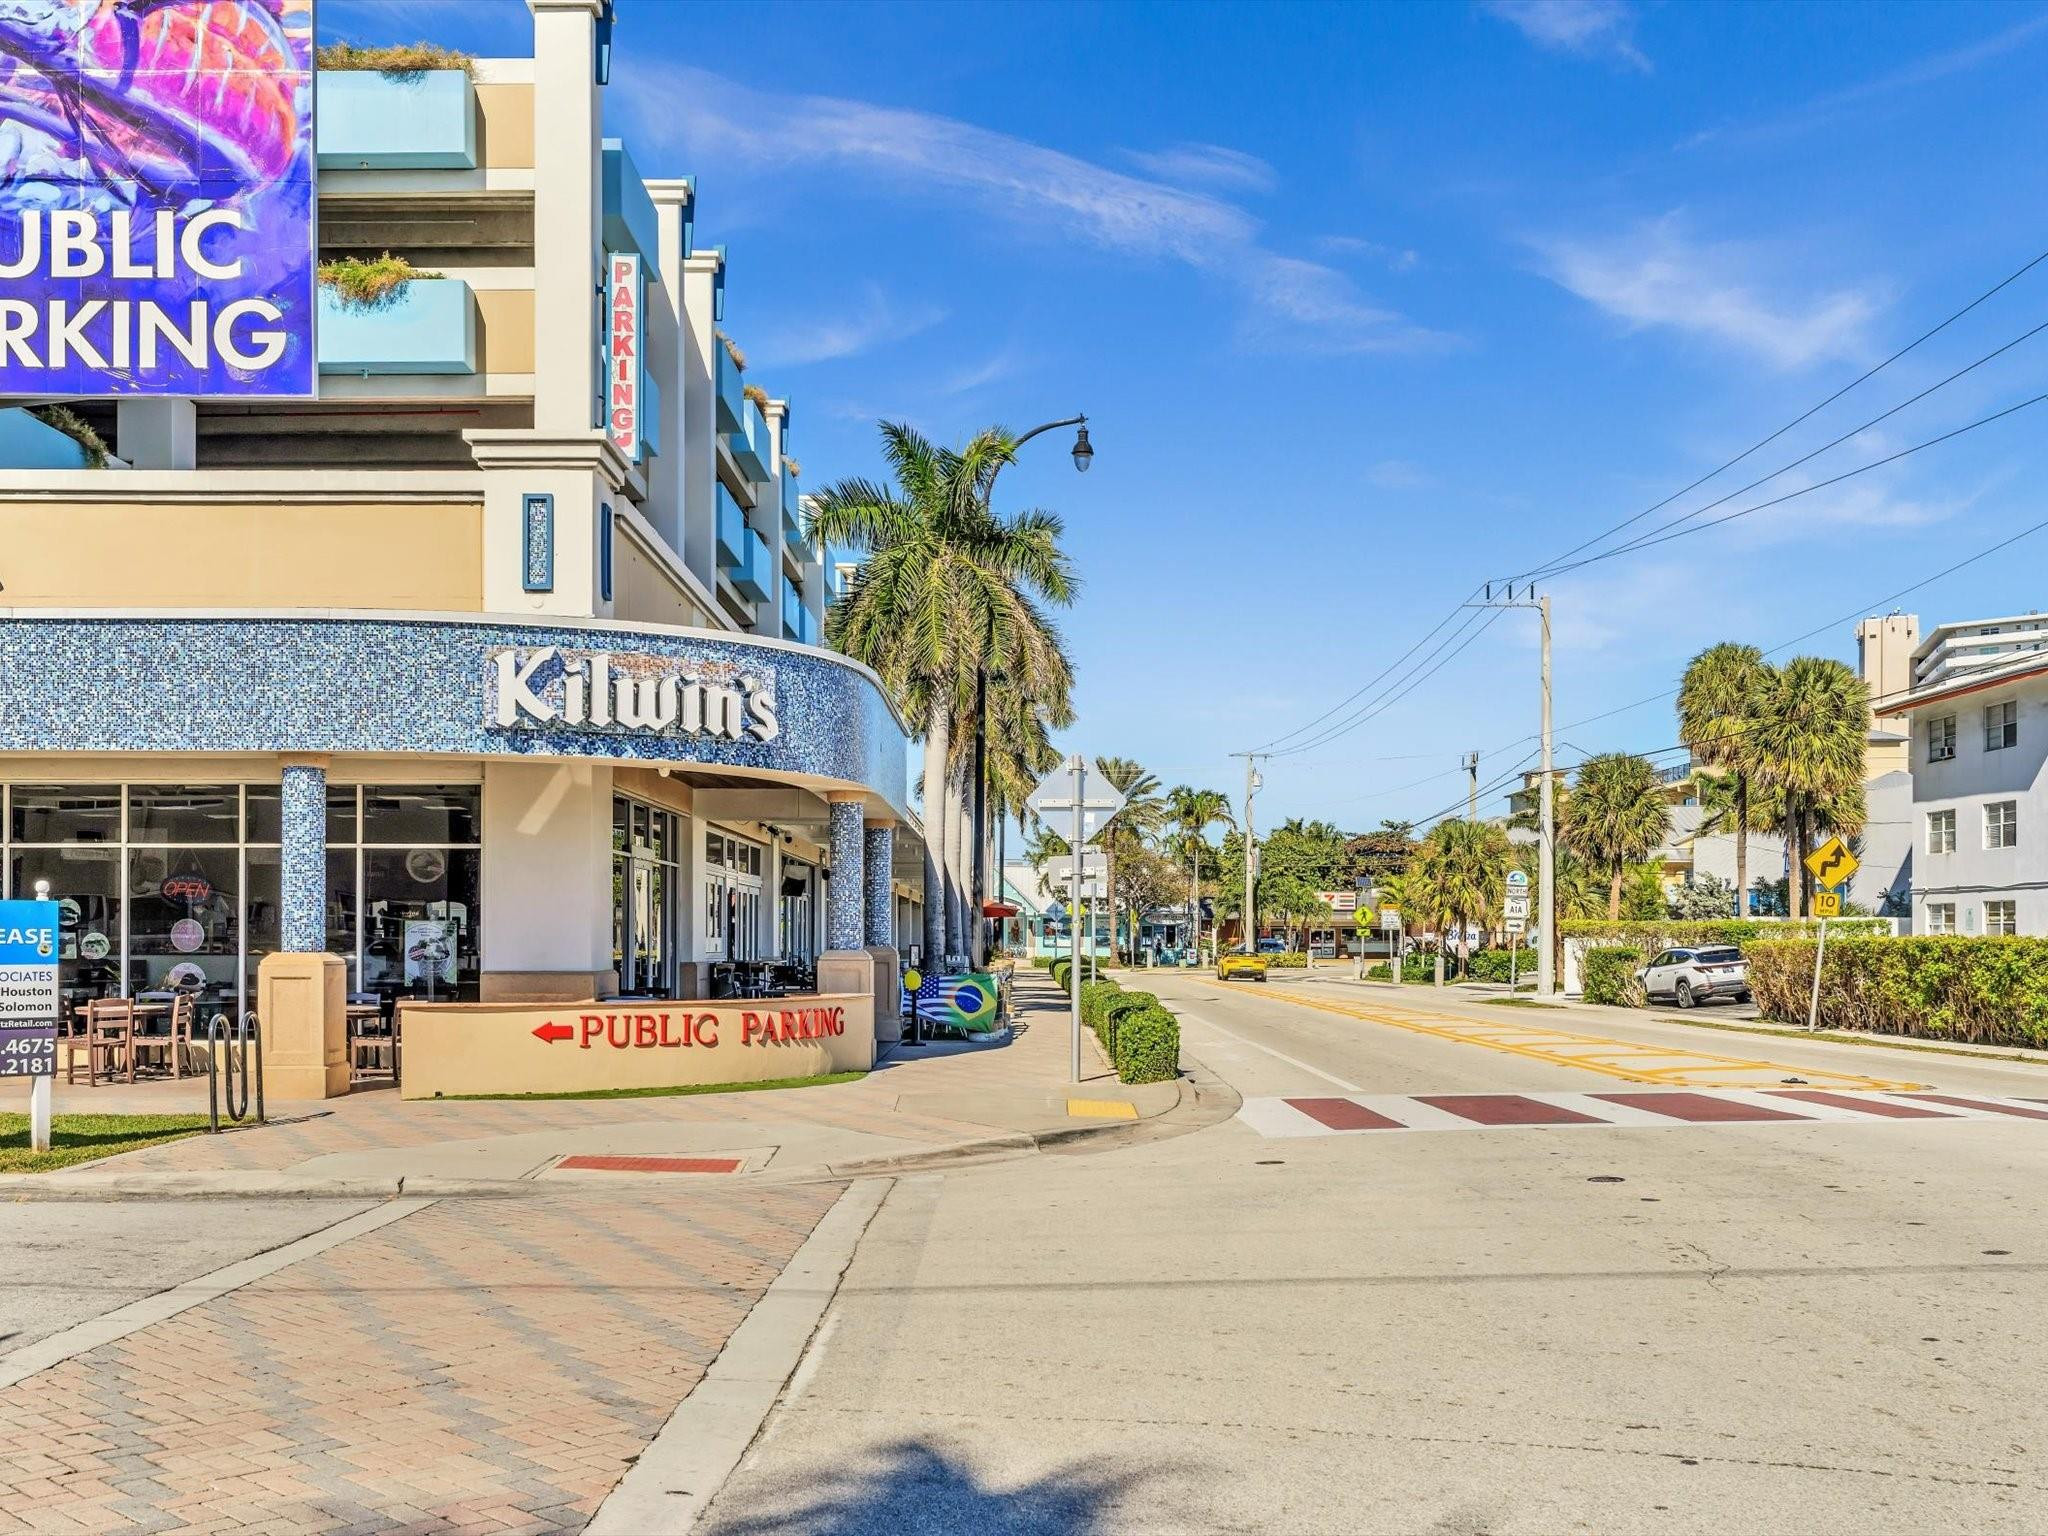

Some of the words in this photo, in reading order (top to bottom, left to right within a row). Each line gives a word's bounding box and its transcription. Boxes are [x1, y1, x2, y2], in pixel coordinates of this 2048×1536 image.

[612, 262, 634, 429] PARKING
[494, 646, 779, 742] Kilwin's
[163, 881, 209, 897] OPEN
[1820, 895, 1835, 907] 10
[1510, 905, 1523, 914] A1A
[1, 987, 52, 996] Houston
[0, 1002, 52, 1011] Solomon
[579, 1012, 719, 1048] PUBLIC
[741, 1007, 845, 1045] PARKING
